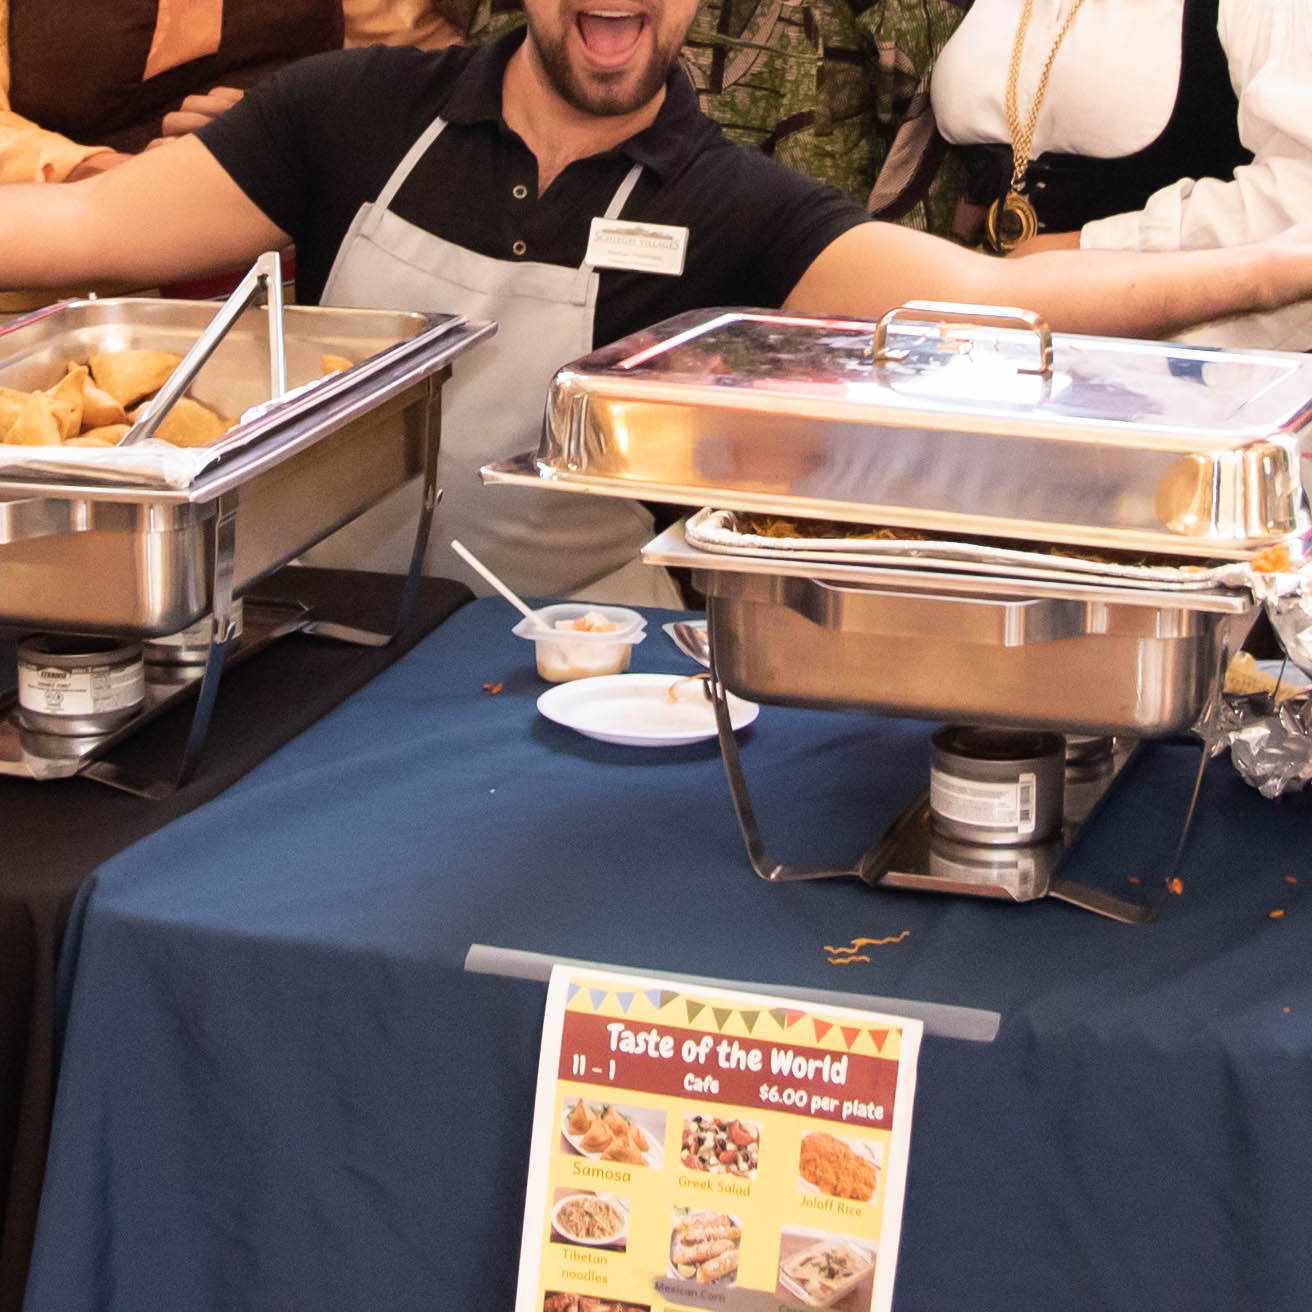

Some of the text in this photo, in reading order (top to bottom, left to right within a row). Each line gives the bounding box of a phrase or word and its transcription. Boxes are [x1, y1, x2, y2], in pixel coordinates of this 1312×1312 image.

[607, 1022, 849, 1085] Taste of the World
[683, 1073, 720, 1094] Cafe
[759, 1083, 884, 1121] $6.00 per plate
[572, 1162, 632, 1183] Samosa
[678, 1175, 750, 1198] Greek Salad
[800, 1194, 862, 1217] Joloff Rice
[562, 1248, 608, 1265] Tibetan
[561, 1269, 608, 1285] noodles
[700, 1290, 726, 1303] Corn
